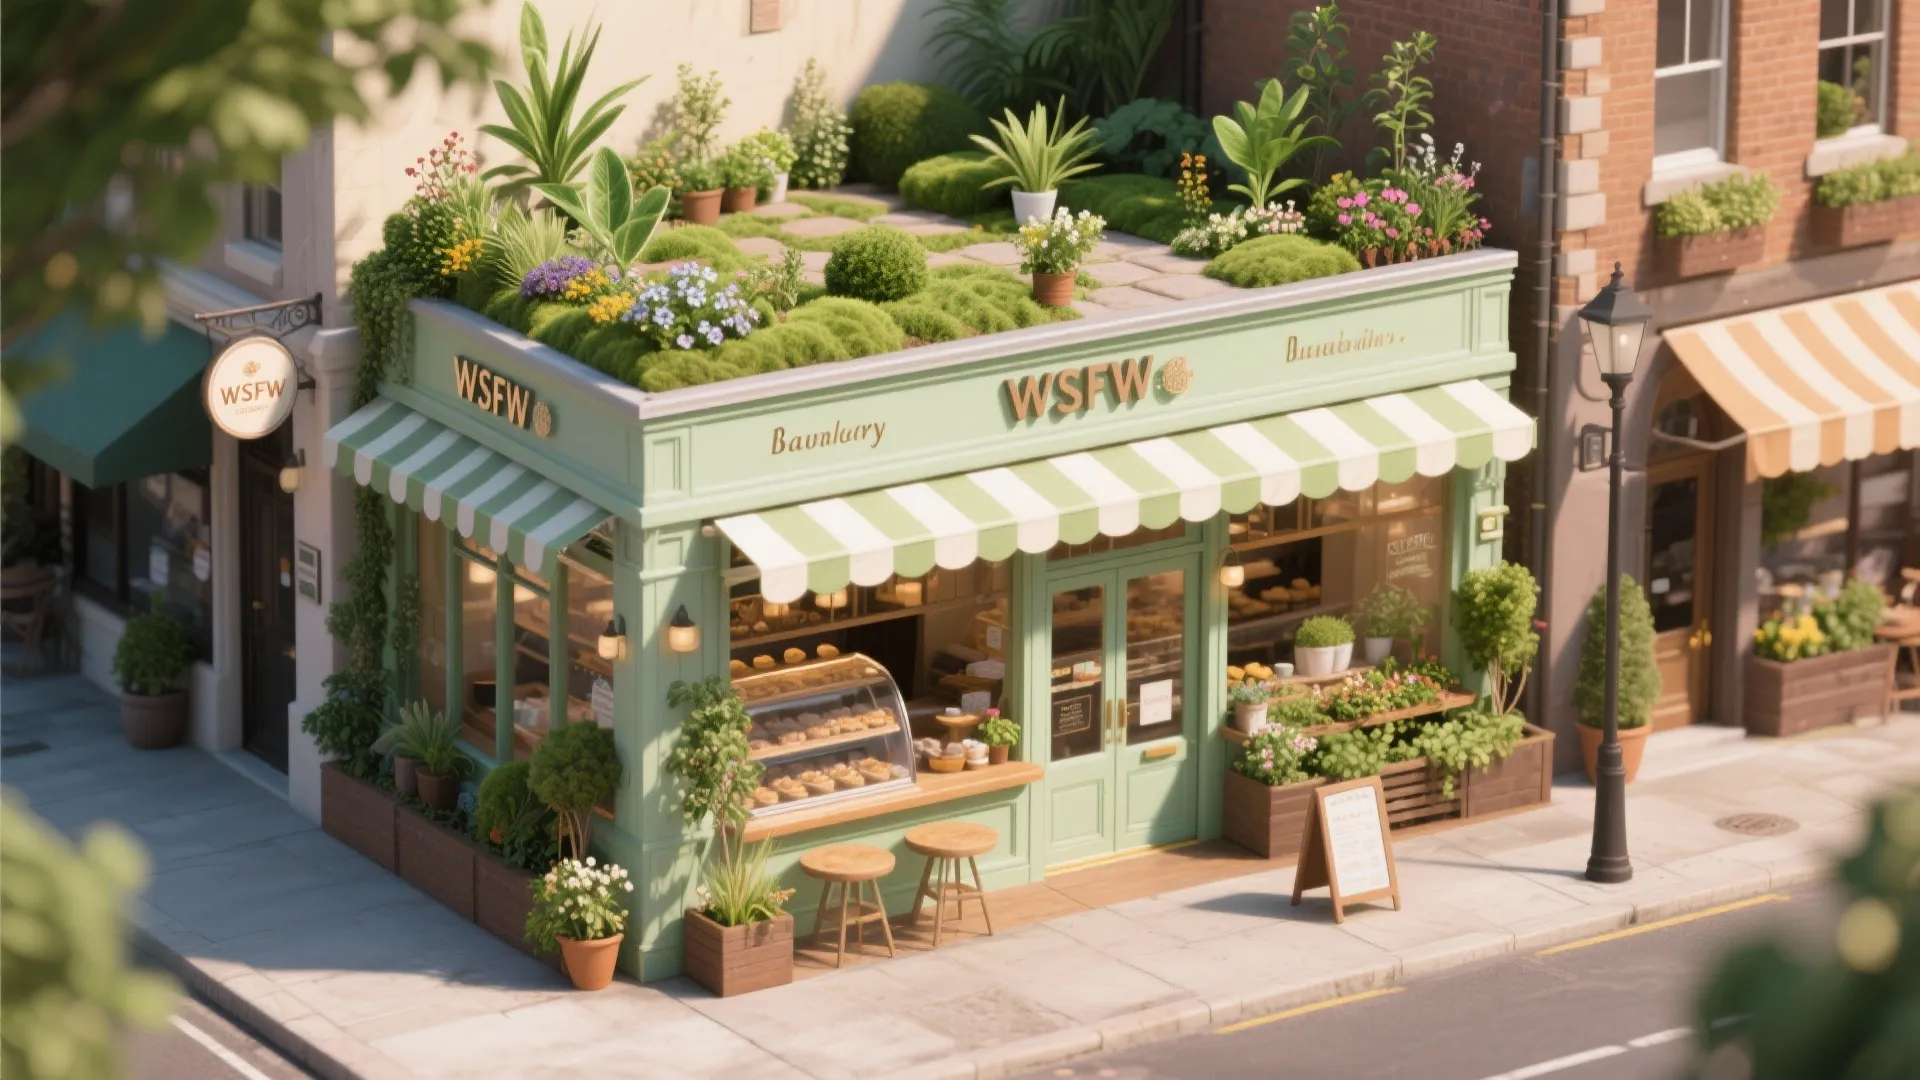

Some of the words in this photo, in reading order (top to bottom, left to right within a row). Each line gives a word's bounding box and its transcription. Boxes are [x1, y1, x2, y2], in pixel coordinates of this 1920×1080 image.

[220, 378, 287, 406] WSFW
[453, 355, 531, 429] WSFW
[1003, 354, 1154, 421] WSFW
